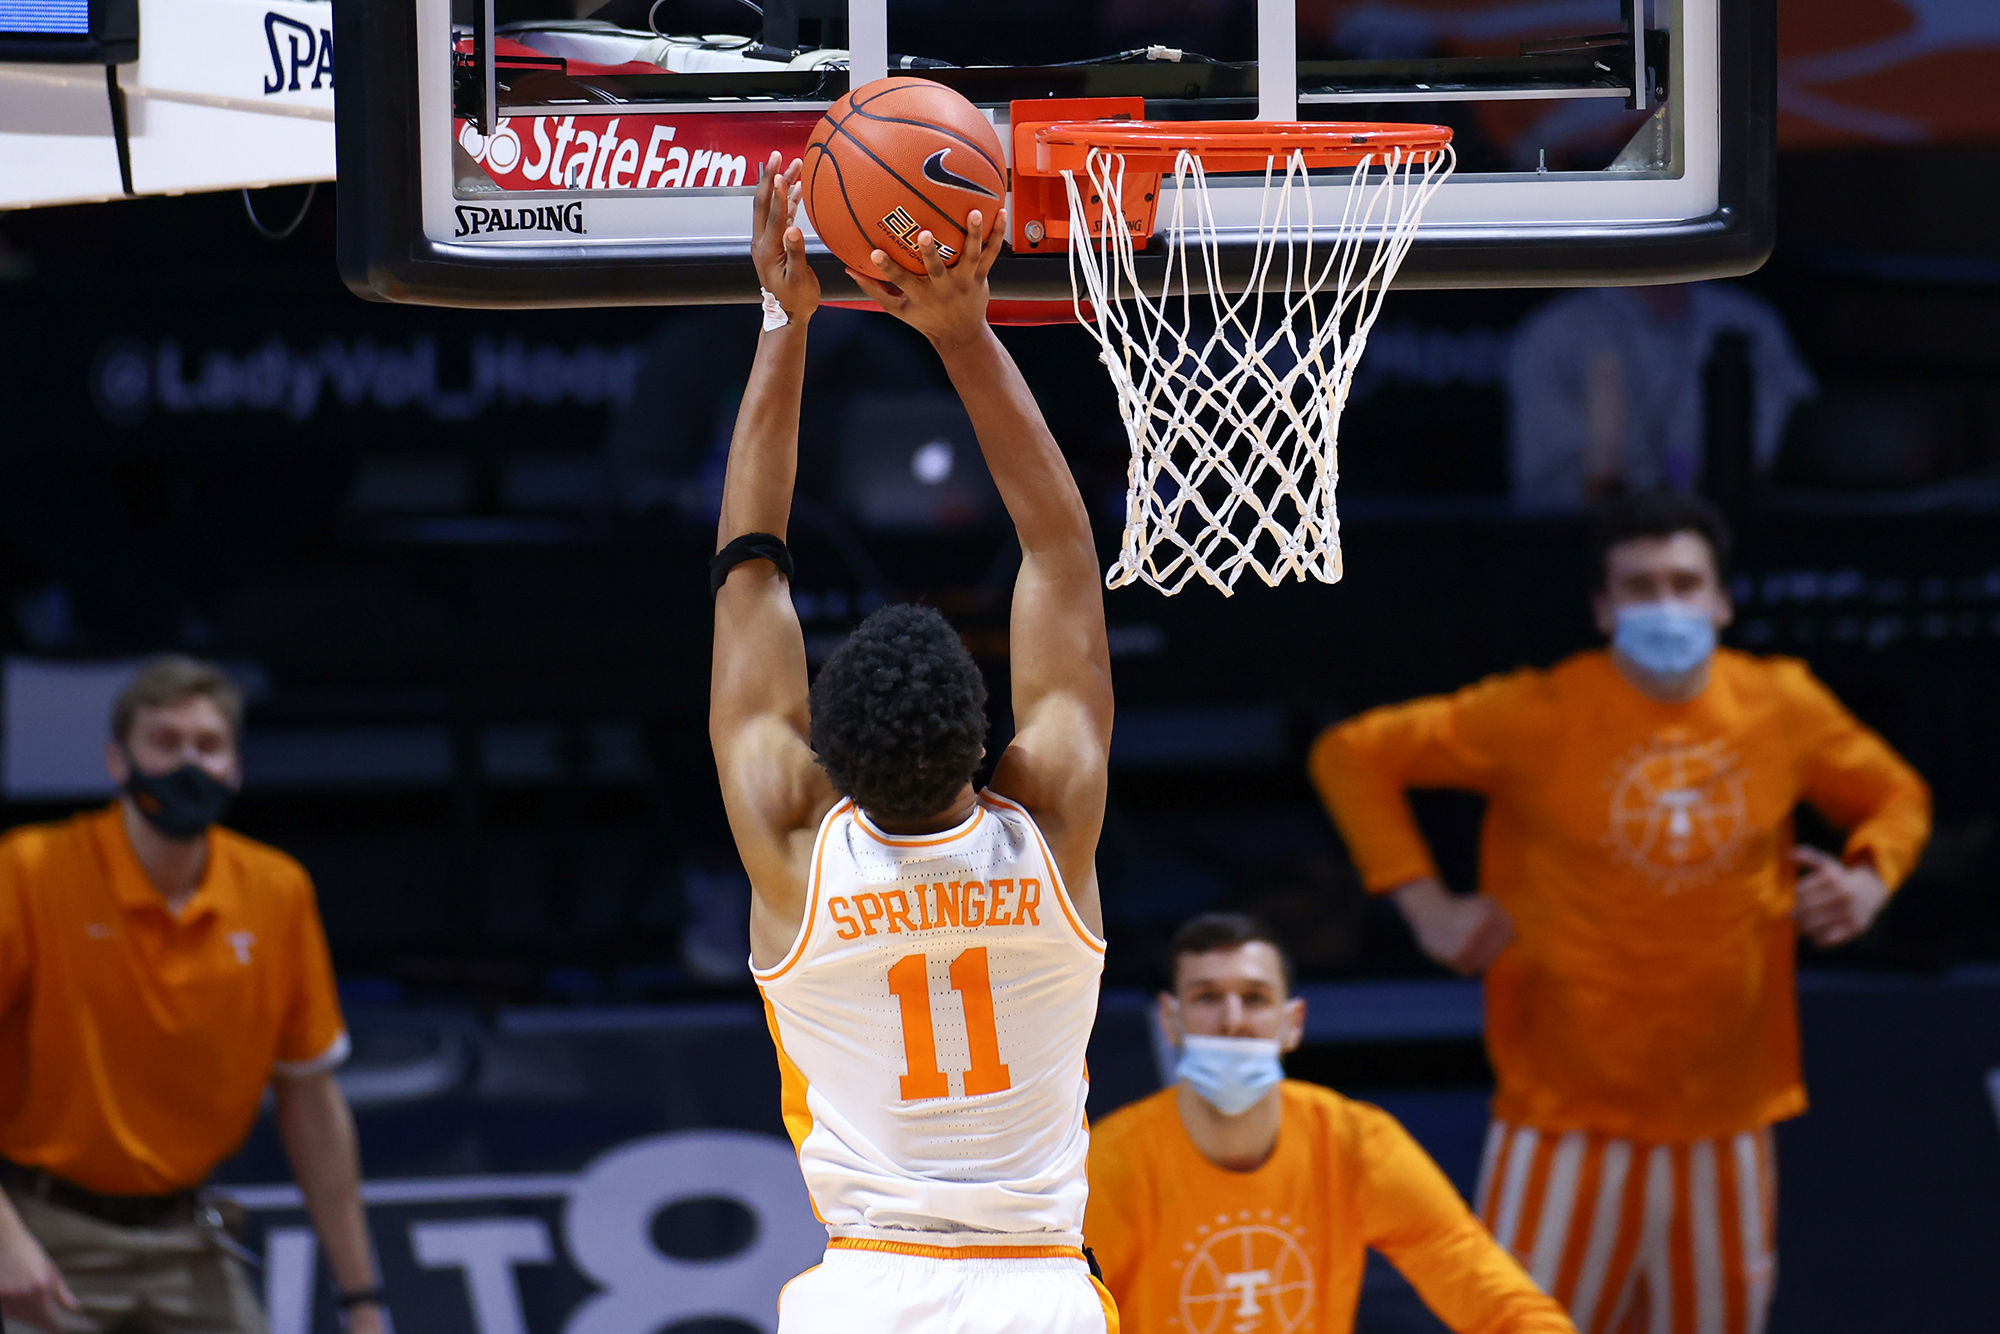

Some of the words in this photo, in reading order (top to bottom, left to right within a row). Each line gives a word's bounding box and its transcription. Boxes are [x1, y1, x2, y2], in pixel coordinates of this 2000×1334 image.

[455, 201, 583, 238] SPALDING
[828, 878, 1041, 940] SPRINGER
[887, 946, 1011, 1100] 11
